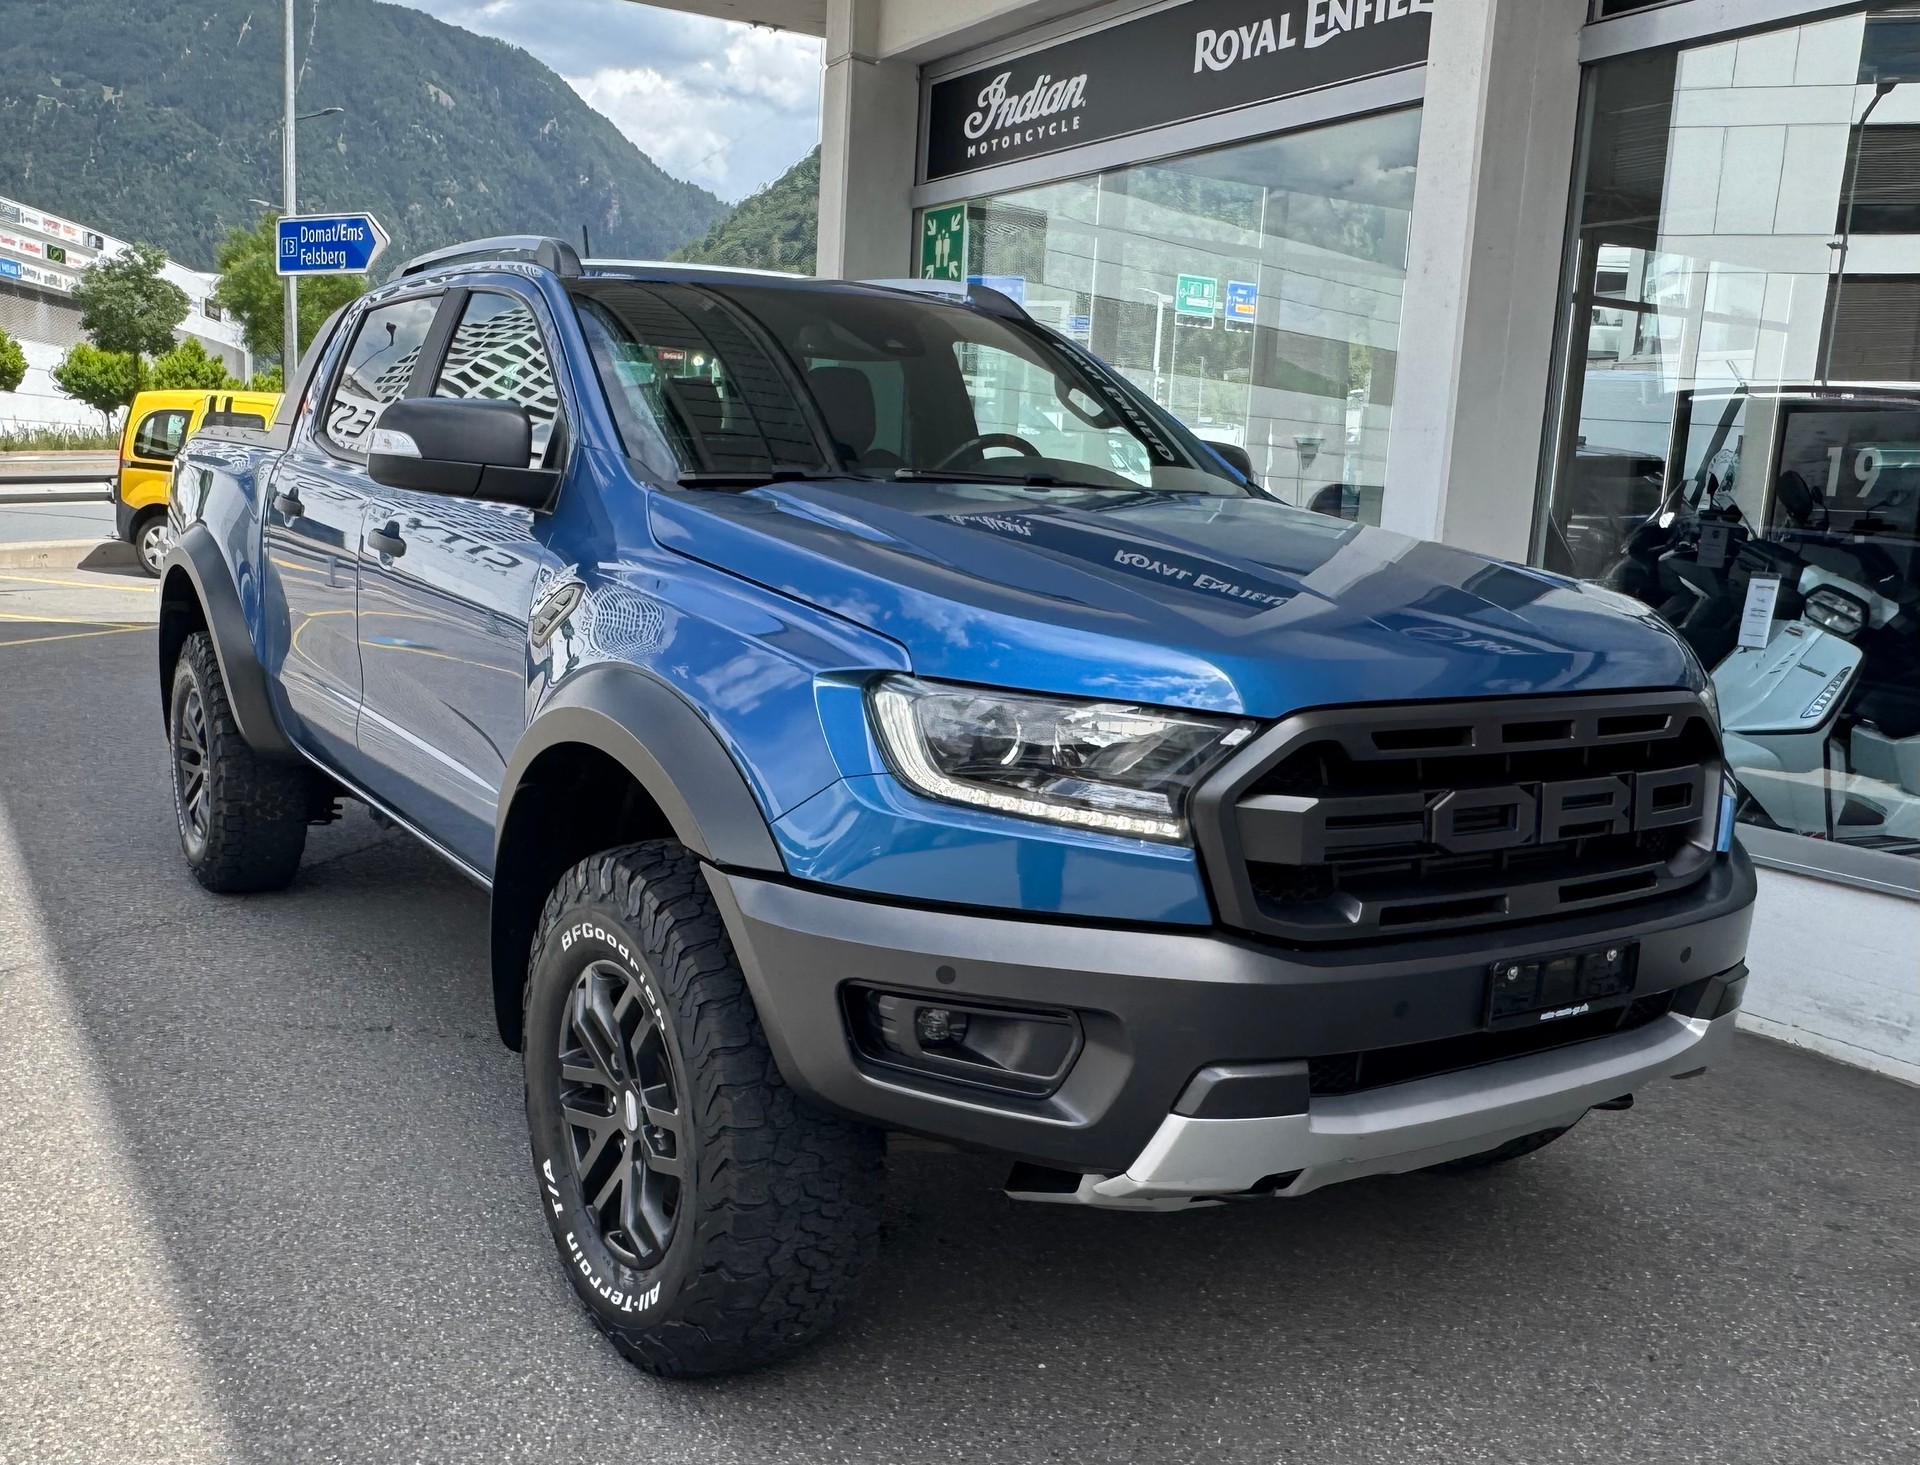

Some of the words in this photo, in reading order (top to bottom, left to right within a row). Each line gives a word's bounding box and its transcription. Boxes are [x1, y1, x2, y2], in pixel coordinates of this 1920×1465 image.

[1193, 12, 1297, 74] ROYAL
[963, 71, 1088, 139] Indian
[967, 116, 1080, 158] MOTORCYCLE
[284, 240, 295, 254] 13
[300, 223, 364, 243] Domat/Ems
[300, 246, 347, 269] Felsberg
[1826, 446, 1882, 498] 19
[1235, 763, 1704, 867] FORD
[561, 922, 666, 1031] BFGoodrich
[542, 1158, 564, 1219] T/A
